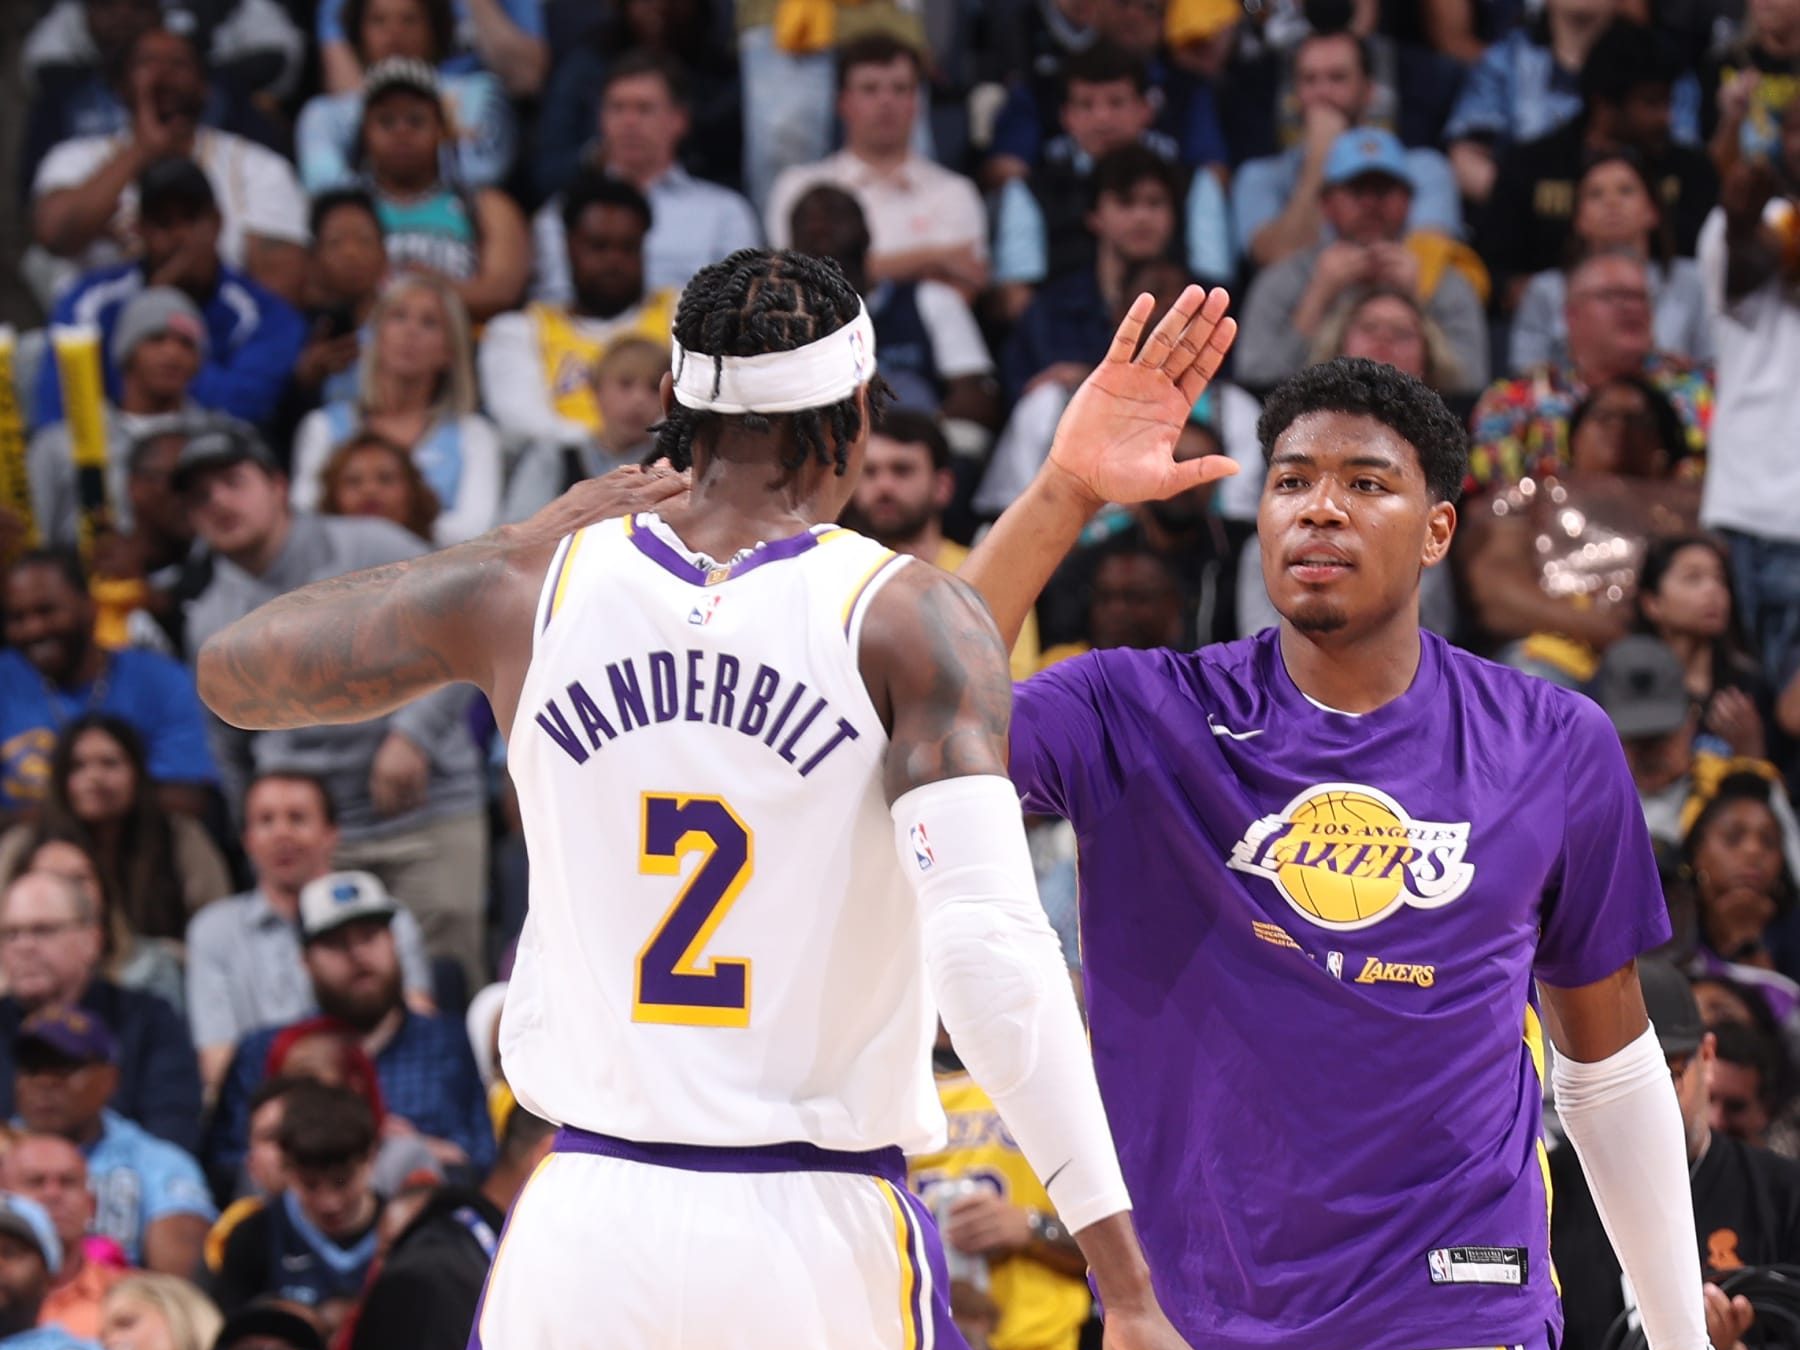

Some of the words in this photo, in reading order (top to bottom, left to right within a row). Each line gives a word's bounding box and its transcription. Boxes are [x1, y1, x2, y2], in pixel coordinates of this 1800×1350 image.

[535, 649, 860, 778] VANDERBILT
[1249, 821, 1460, 899] LAKERS
[1311, 822, 1349, 836] LOS
[1355, 826, 1458, 841] ANGELES
[631, 790, 754, 1028] 2
[1354, 957, 1436, 988] LAKERS
